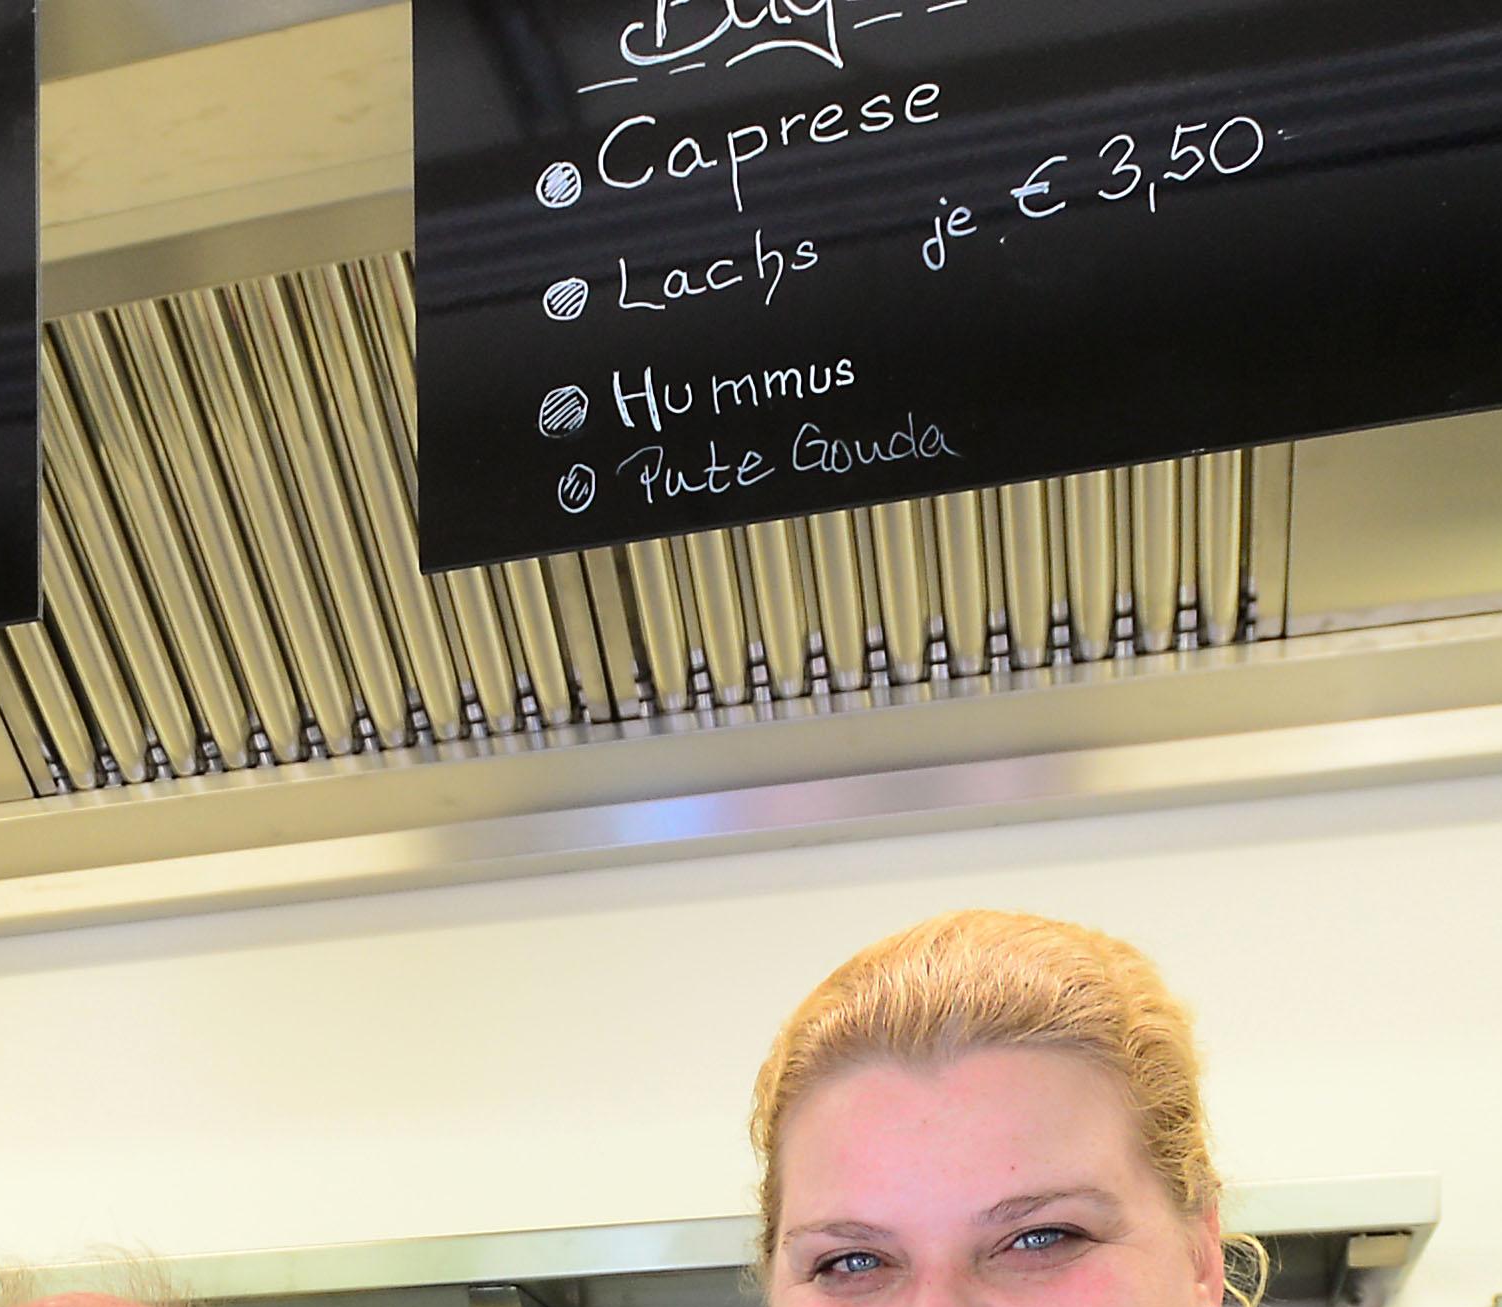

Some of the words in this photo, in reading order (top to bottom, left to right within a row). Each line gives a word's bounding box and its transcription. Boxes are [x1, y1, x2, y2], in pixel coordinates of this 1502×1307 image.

[598, 83, 941, 212] Caprese
[617, 226, 820, 315] Lachs
[921, 197, 978, 271] je
[1010, 154, 1069, 218] €
[1095, 115, 1264, 214] 3,50
[611, 355, 856, 433] Hummus
[616, 441, 776, 505] Pute
[792, 421, 959, 473] Gouda
